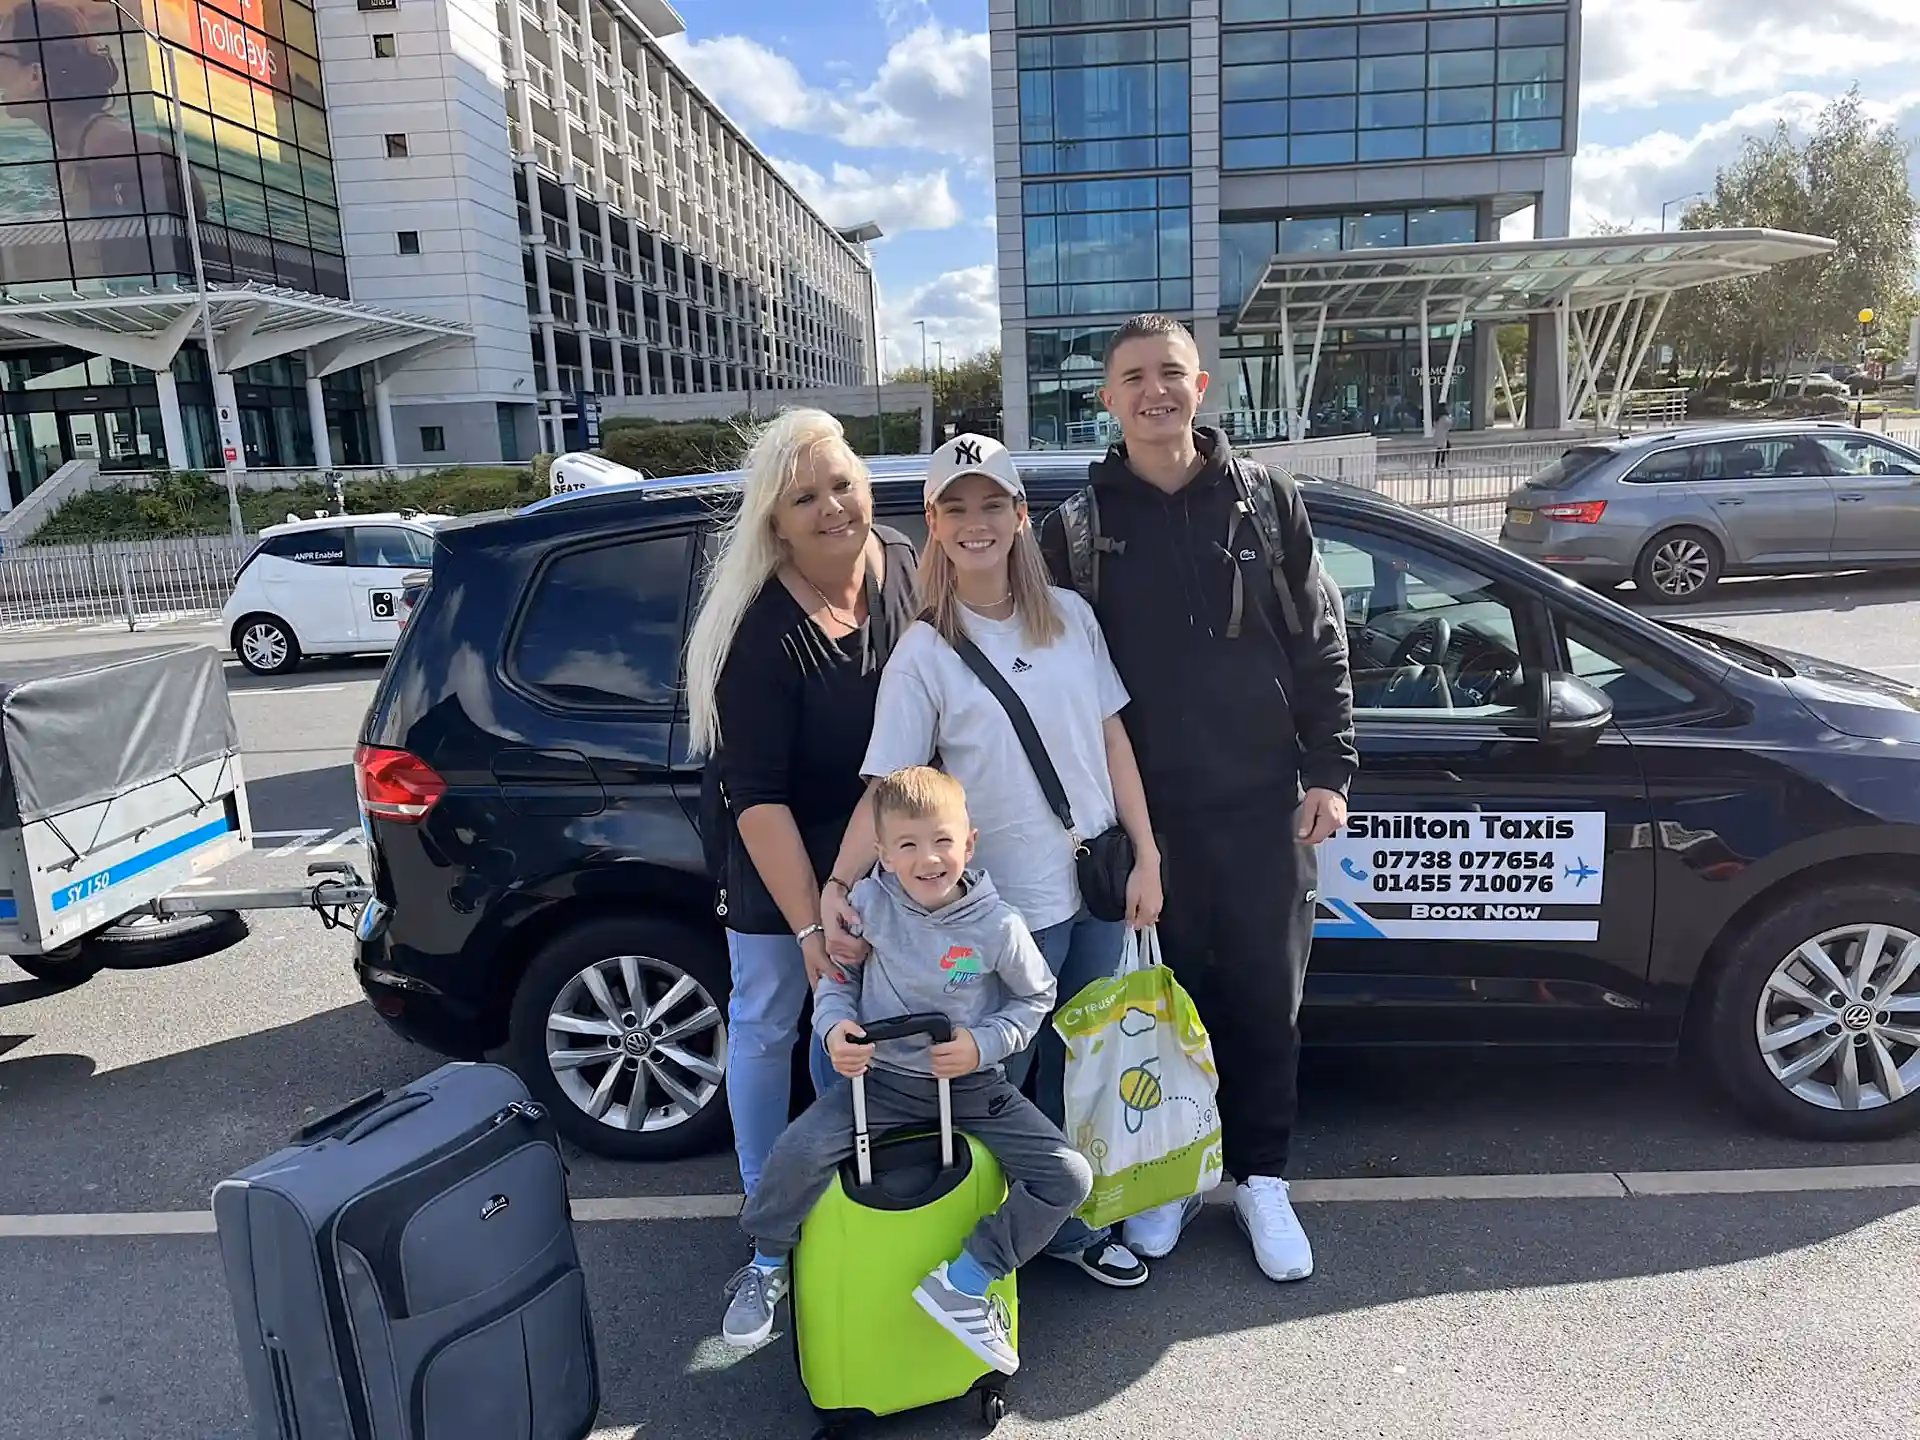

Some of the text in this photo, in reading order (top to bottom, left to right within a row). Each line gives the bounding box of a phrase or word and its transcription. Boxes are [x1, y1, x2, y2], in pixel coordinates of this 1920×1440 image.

[200, 4, 277, 76] holidays
[556, 471, 564, 484] 6
[315, 550, 343, 559] Enabled
[1346, 815, 1470, 839] Shilton
[1480, 816, 1574, 839] Taxis
[1373, 851, 1554, 870] 07738 077654
[67, 871, 110, 904] SY 150
[1373, 874, 1554, 893] 01455 710076
